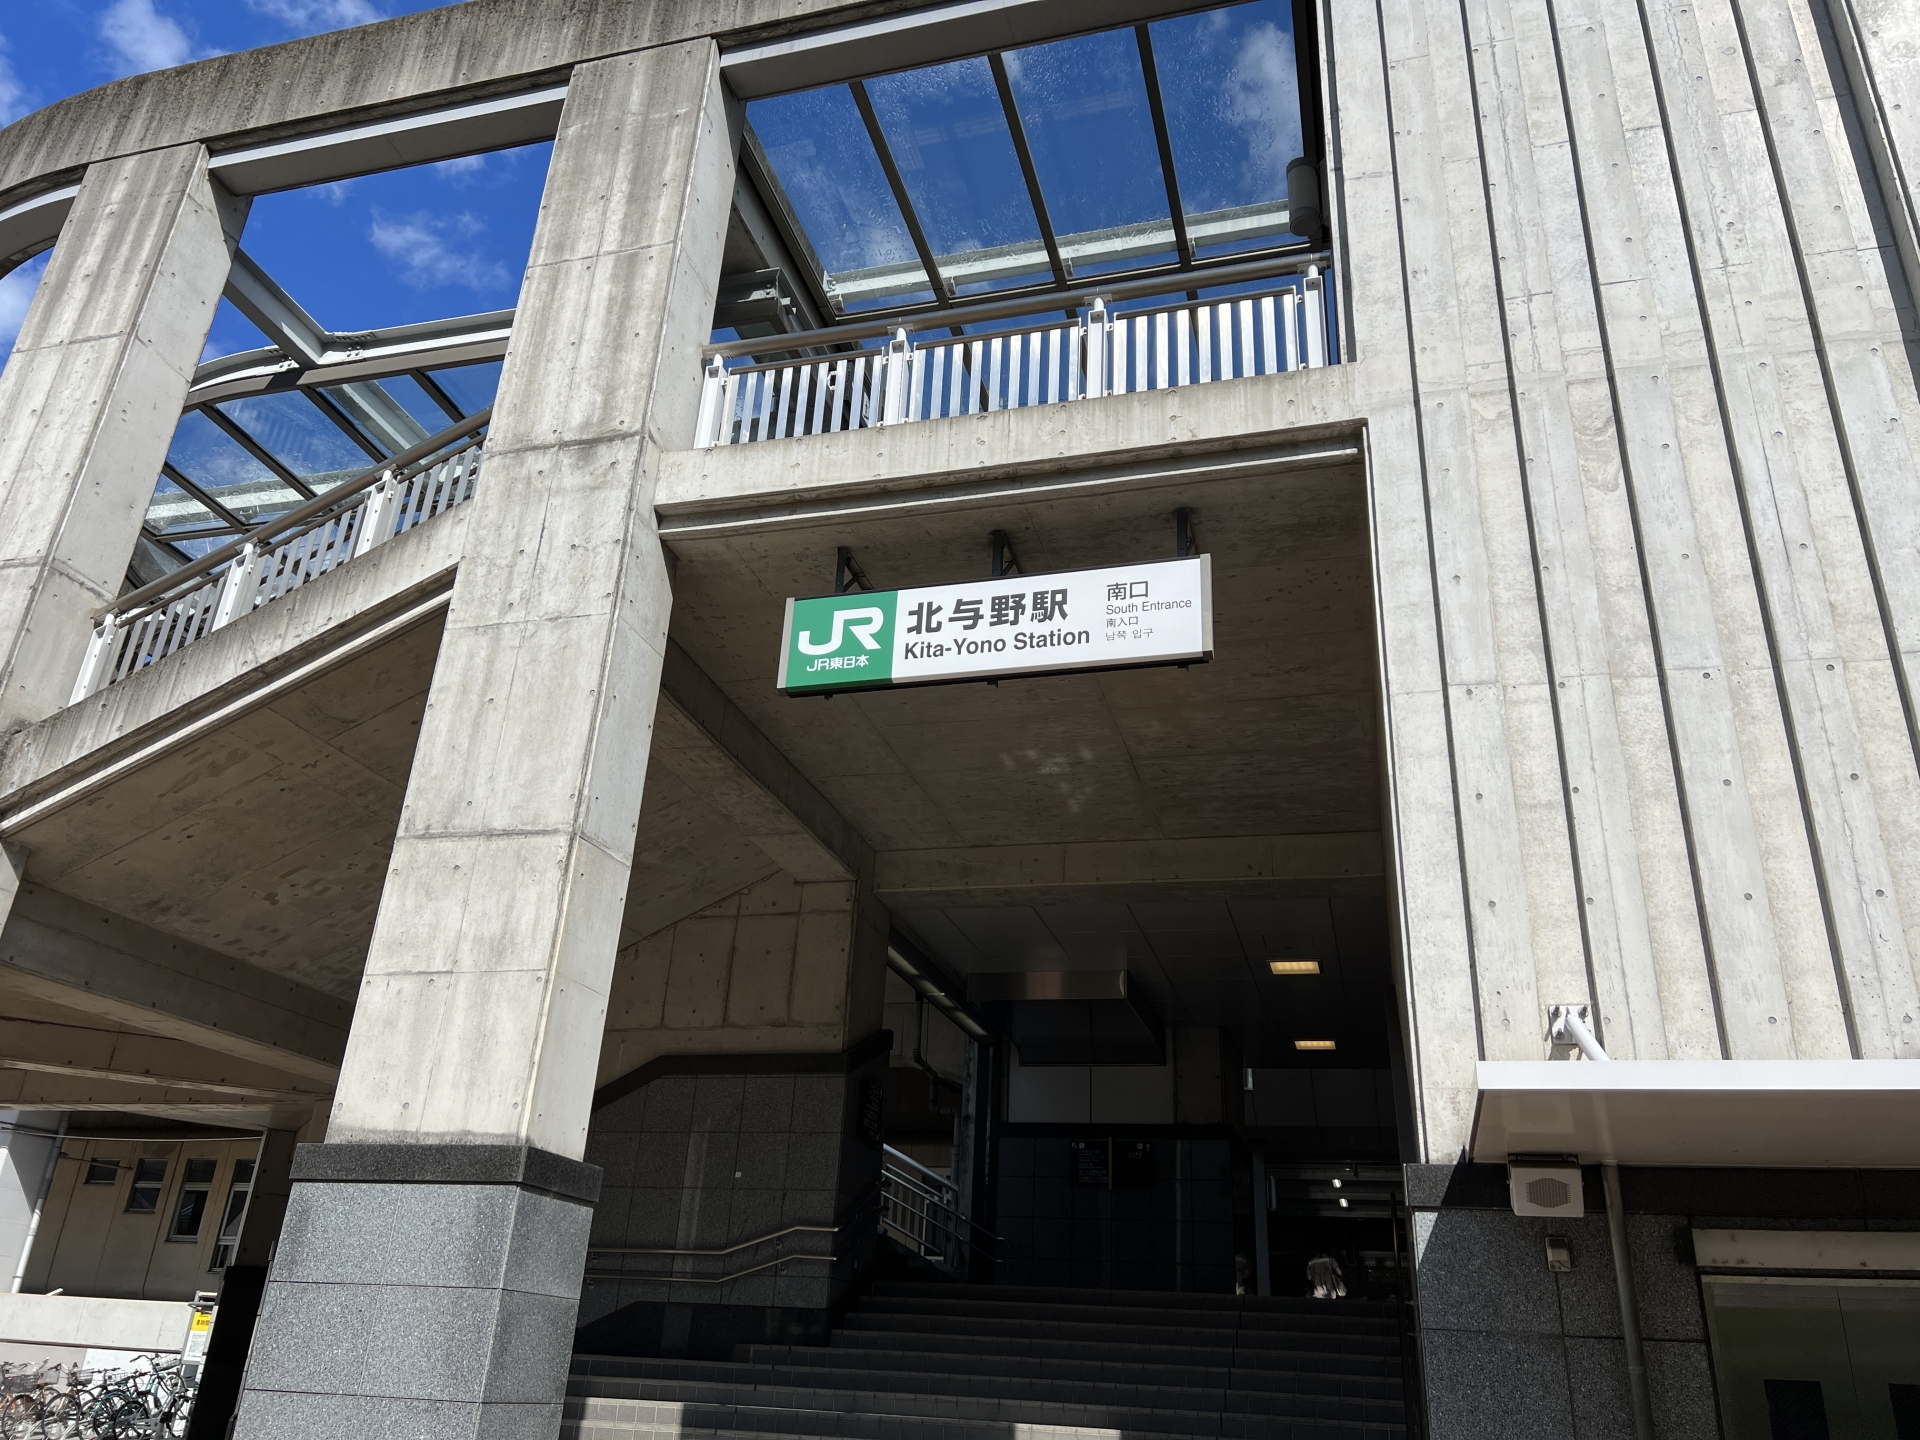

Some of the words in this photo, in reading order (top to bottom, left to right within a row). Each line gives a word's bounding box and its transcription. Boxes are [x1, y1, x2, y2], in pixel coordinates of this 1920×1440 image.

[1106, 580, 1149, 602] 南口
[906, 588, 1069, 635] 北与野駅
[1106, 602, 1138, 615] South
[1142, 599, 1192, 612] Entrance
[797, 606, 884, 656] JR
[1106, 616, 1139, 628] 南入口
[1105, 630, 1127, 641] 남쪽
[1132, 628, 1154, 639] 입구
[904, 637, 1007, 661] Kita-Yono
[1013, 629, 1091, 650] Station
[806, 653, 870, 672] JR東日本
